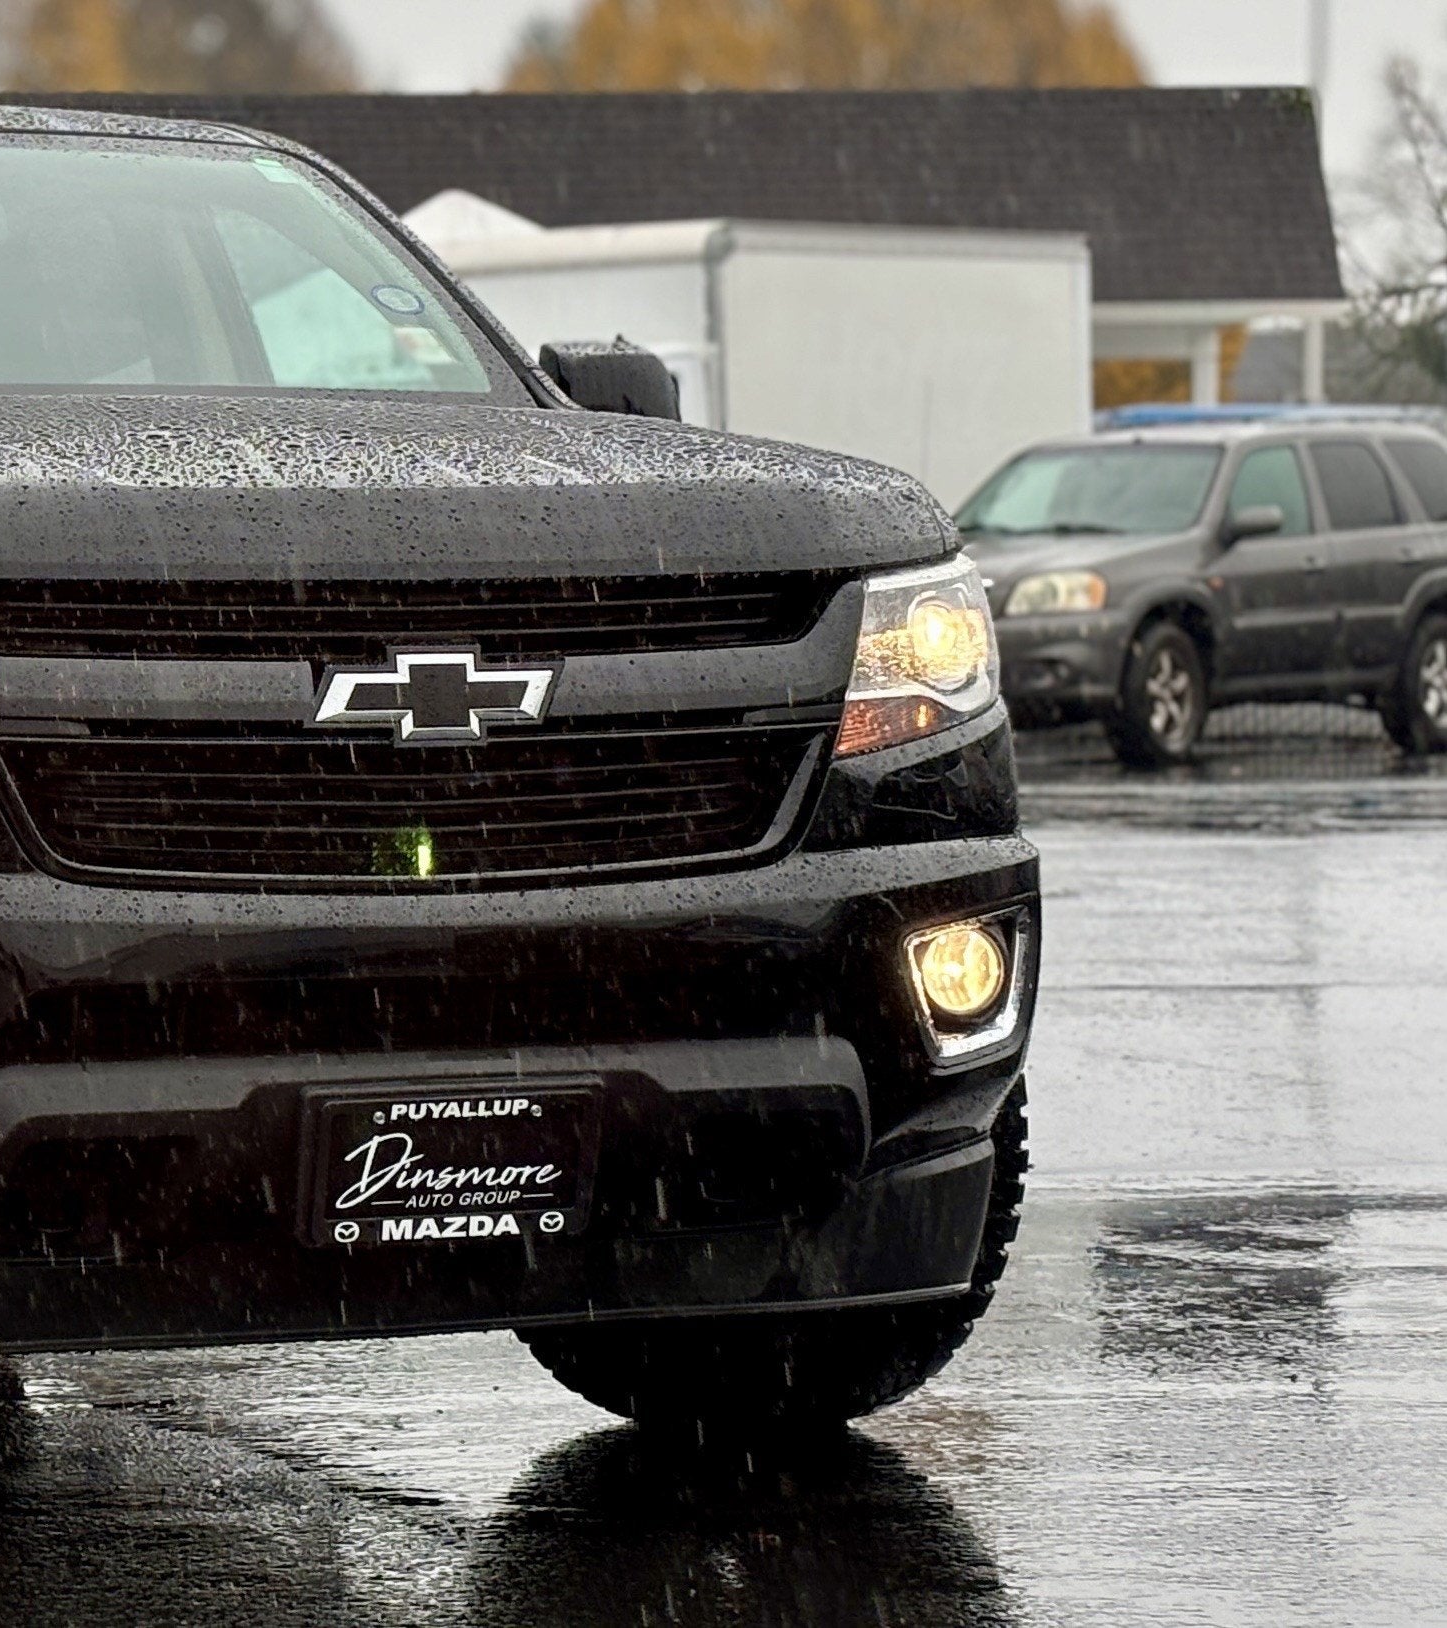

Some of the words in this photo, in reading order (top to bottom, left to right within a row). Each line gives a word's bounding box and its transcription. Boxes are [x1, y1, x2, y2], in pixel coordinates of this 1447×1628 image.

[390, 1099, 529, 1121] PUYALLUP
[335, 1132, 563, 1209] Dinsmore
[405, 1193, 454, 1209] AUTO
[458, 1190, 522, 1206] GROUP
[381, 1213, 521, 1241] MAZDA
